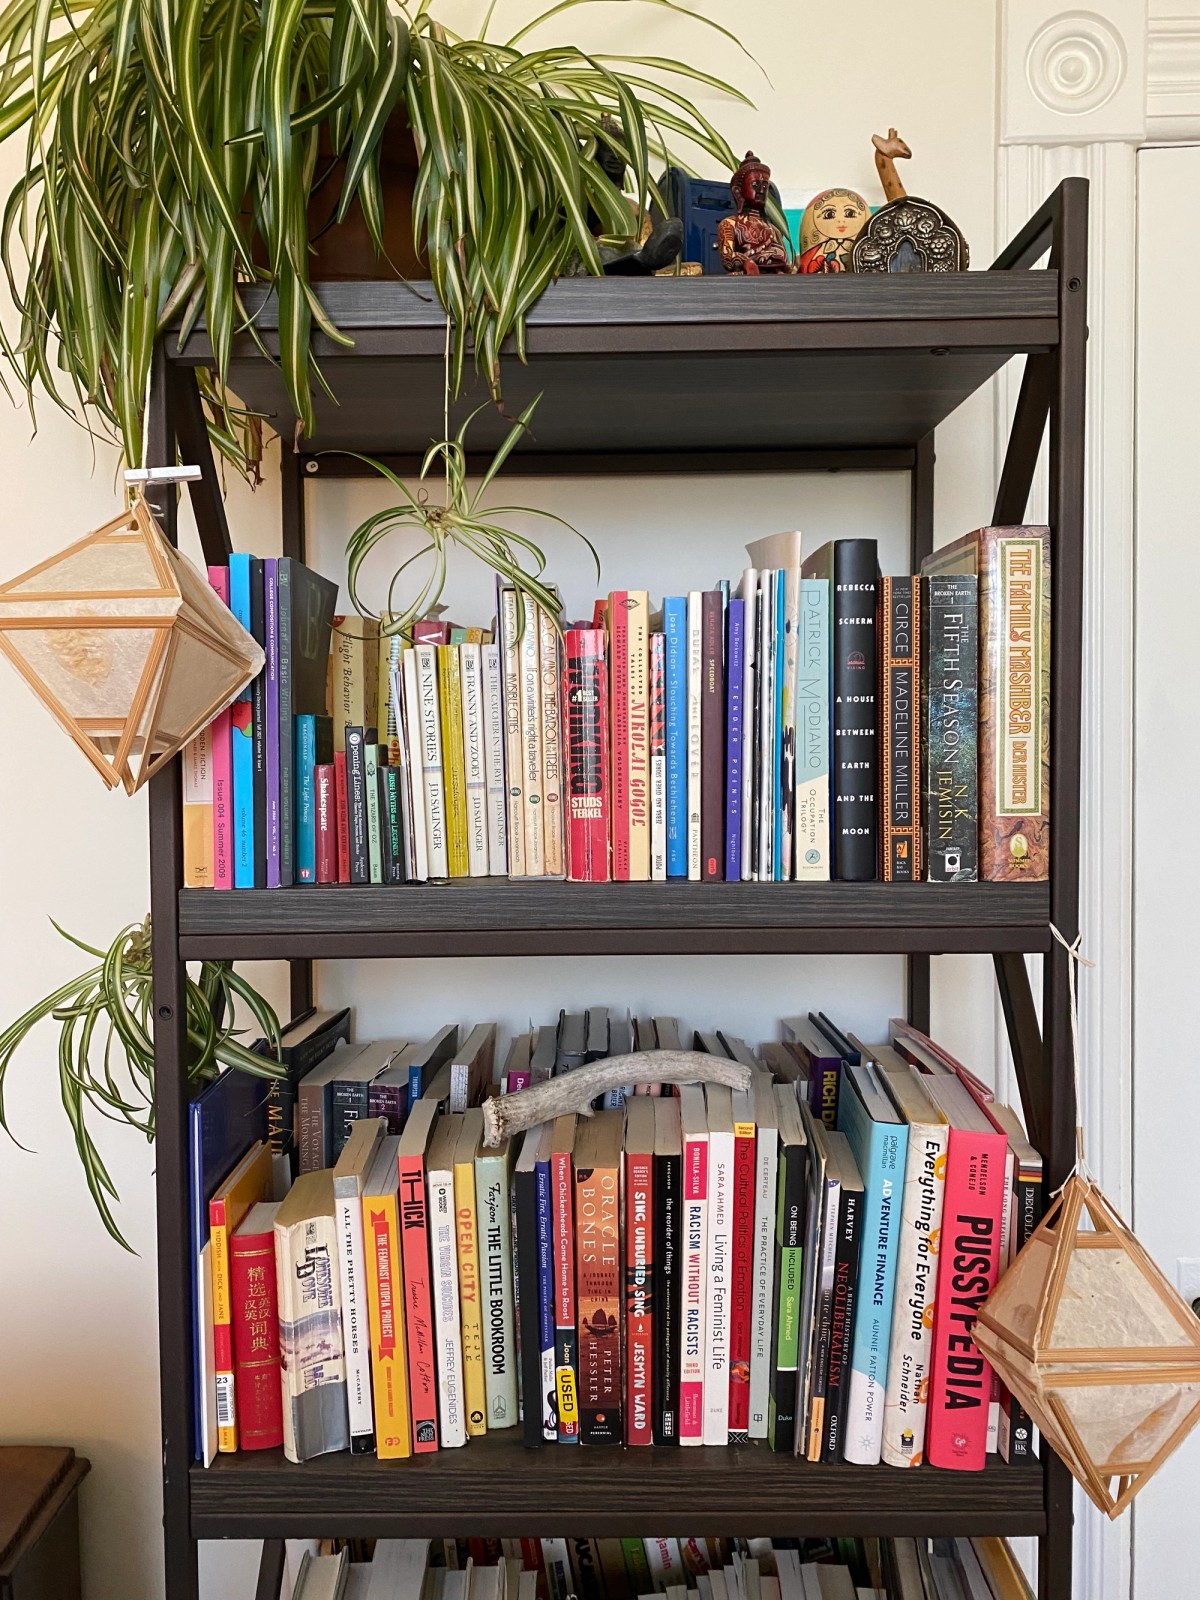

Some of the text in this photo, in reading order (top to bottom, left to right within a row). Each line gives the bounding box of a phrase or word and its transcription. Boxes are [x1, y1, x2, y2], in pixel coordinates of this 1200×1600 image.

[1009, 549, 1032, 576] THE
[895, 603, 909, 652] CIRCE
[960, 625, 970, 643] THE
[1009, 580, 1032, 642] FAMILY
[342, 633, 353, 713] Flight Behavior
[508, 673, 519, 734] INVISIBLE CITIES
[631, 686, 635, 695] OF
[799, 590, 821, 769] PATRICK MODIANO
[943, 613, 964, 764] FIFTH SEASON
[1009, 646, 1032, 734] MASHBER
[568, 657, 603, 819] WORKING STUDS TERKEL
[669, 613, 678, 824] Joan Didion Slouching Towards Bethlehem
[895, 672, 909, 758] MADELINE
[388, 773, 396, 790] IRISH
[422, 674, 442, 850] NINE STORIES J.D. SALINGER
[466, 675, 483, 851] FRANNY AND ZOOEY J.D. SALINGER
[631, 699, 646, 826] NIKOLAI GOGOL
[1013, 740, 1027, 764] DER
[319, 778, 329, 831] Shakespeare
[895, 764, 909, 821] MILLER
[936, 770, 953, 840] JEMISIN
[955, 785, 969, 823] N. K.
[822, 1070, 837, 1106] RICH
[881, 1135, 890, 1169] macmillan
[887, 1135, 899, 1170] palgrave
[402, 1170, 424, 1230] THICK
[539, 1173, 549, 1268] Erratic Fire, Erratic Passion
[582, 1188, 596, 1263] BONES
[601, 1176, 615, 1267] ORACLE
[633, 1192, 646, 1225] SING,
[736, 1140, 750, 1311] The Cultural Politics of Emotion
[458, 1208, 476, 1302] OPEN CITY
[558, 1157, 570, 1320] When Chickenheads Come Home to Roost
[633, 1227, 646, 1287] UNBURIED,
[687, 1147, 702, 1356] BONILLA-SILVA RACISM WITHOUT RACISTS
[711, 1163, 726, 1370] SARA AHMED Living a Feminist Life
[909, 1140, 941, 1340] Everything for Everyone
[347, 1260, 356, 1304] PRETTY
[377, 1233, 393, 1338] THE FEMINIST UTOPIA PROJECT
[484, 1183, 505, 1375] Farjeon THE LITTLE BOOKROOM
[785, 1205, 798, 1341] ON BEING INCLUDED Sara Ahmed
[865, 1178, 893, 1422] ADVENTURE FINANCE AUNNIE PATTON POWER
[350, 1308, 359, 1354] HORSES
[439, 1225, 458, 1424] THE VIRGIN SUICIDES JEFFREY EUGENIDES
[634, 1290, 645, 1318] SING
[828, 1198, 855, 1451] HARVEY OXFORD
[828, 1262, 849, 1387] NEOLIBERALISM
[944, 1214, 994, 1411] PUSSYPEDIA
[464, 1325, 472, 1362] COLE
[472, 1323, 481, 1361] TEJU
[563, 1343, 572, 1363] Joan
[589, 1342, 598, 1402] HESSLER
[603, 1350, 612, 1394] PETER
[634, 1342, 645, 1389] JESMYN
[560, 1374, 574, 1412] USED
[634, 1394, 645, 1430] WARD
[899, 1354, 913, 1414] Schneider
[912, 1364, 924, 1405] Nathan
